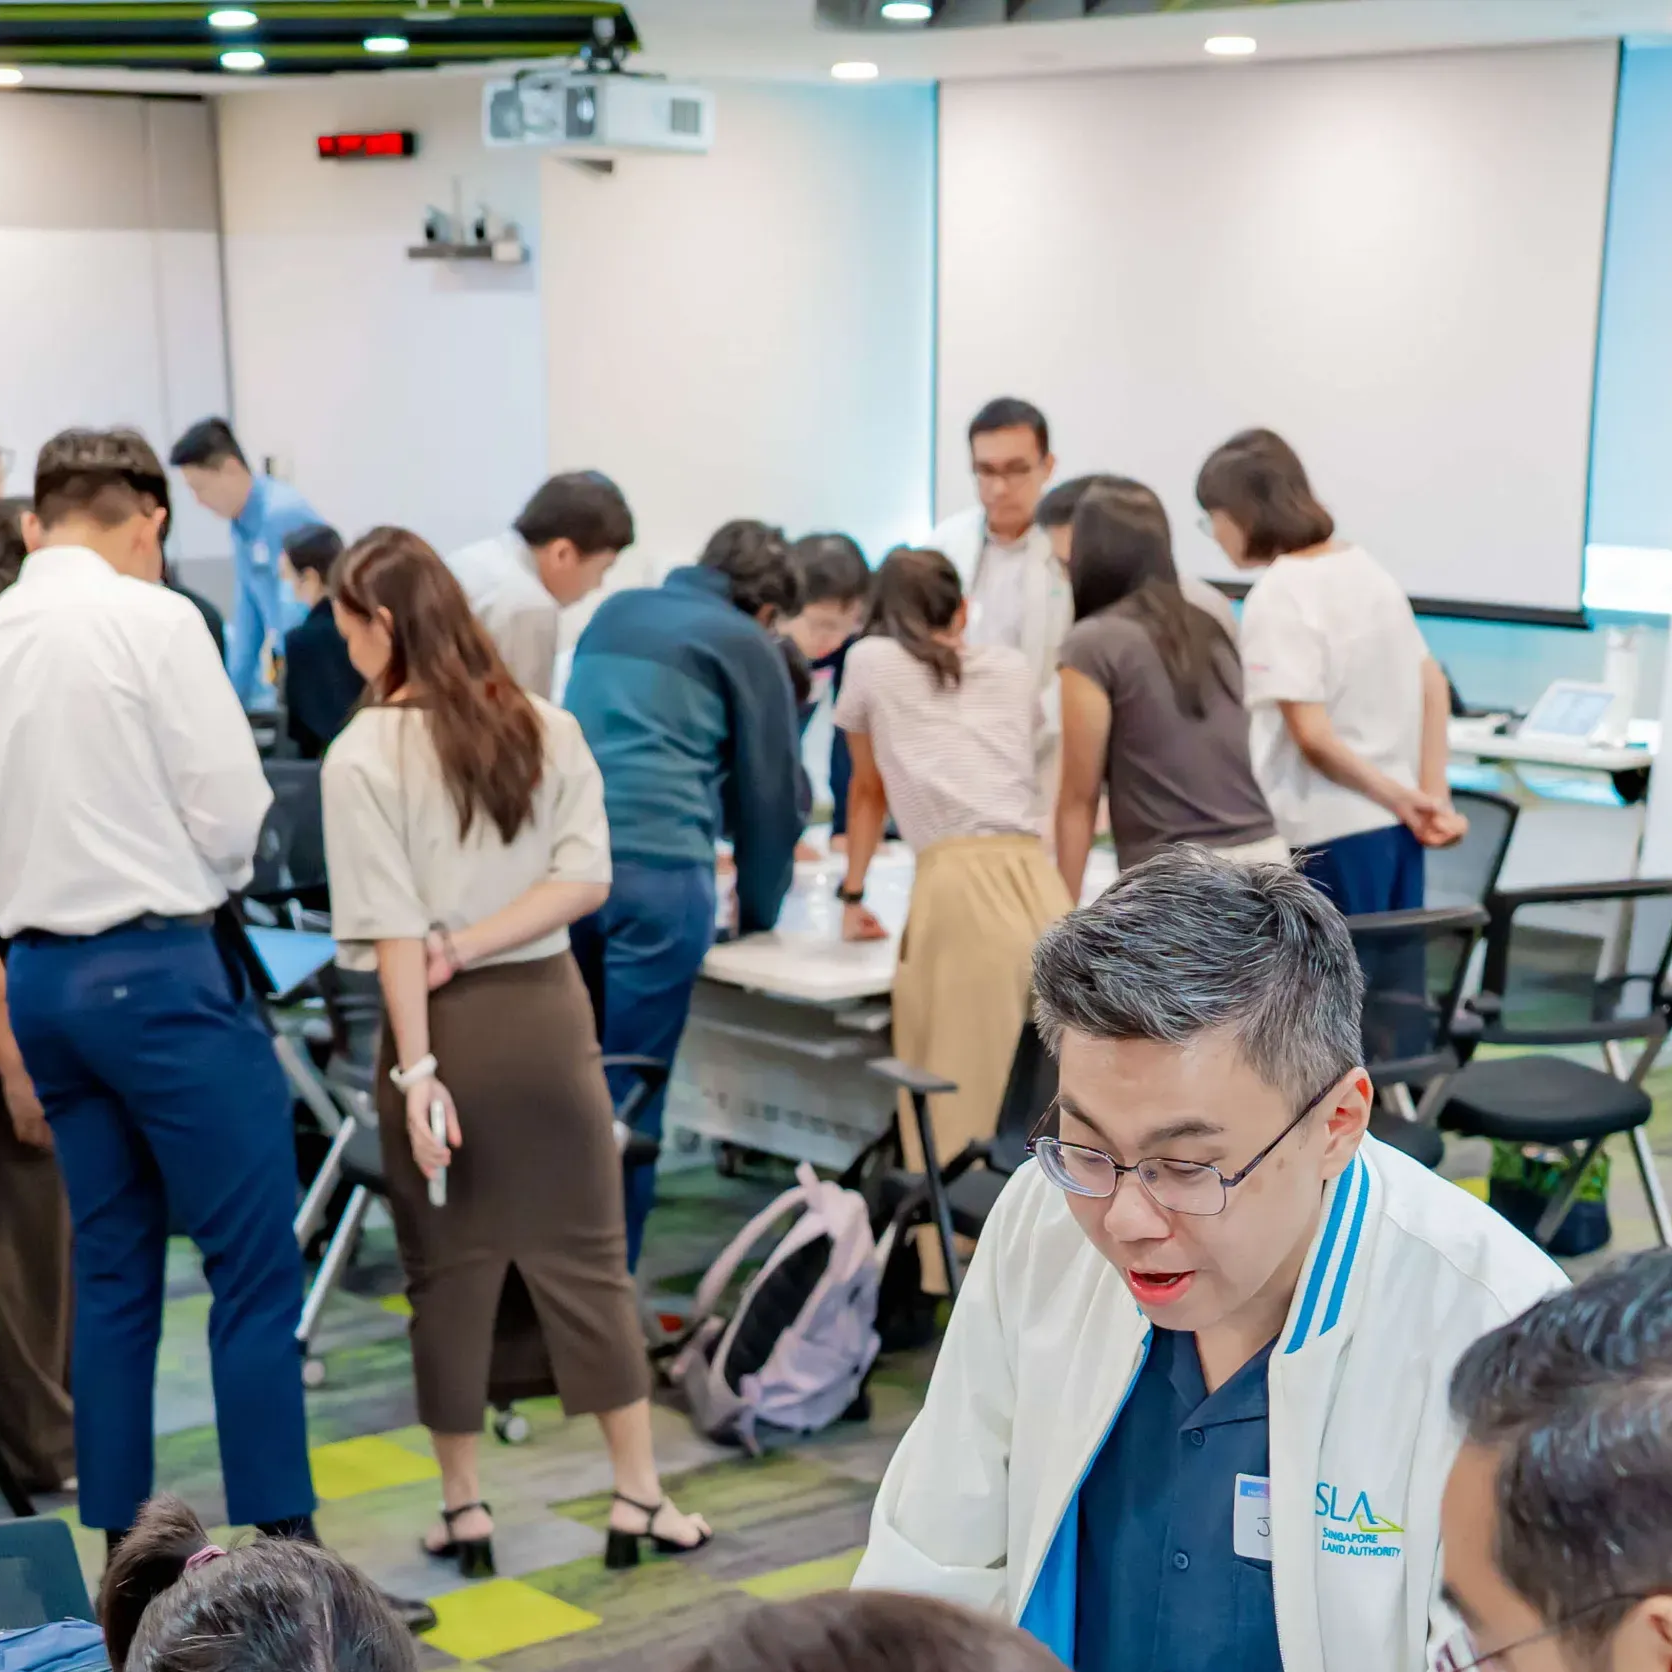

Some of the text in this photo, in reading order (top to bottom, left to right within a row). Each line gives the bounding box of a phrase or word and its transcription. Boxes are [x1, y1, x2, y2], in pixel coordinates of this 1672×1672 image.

[1315, 1482, 1379, 1525] SLA
[1322, 1527, 1379, 1544] SINGAPORE
[1321, 1539, 1401, 1560] LAND AUTHORITY
